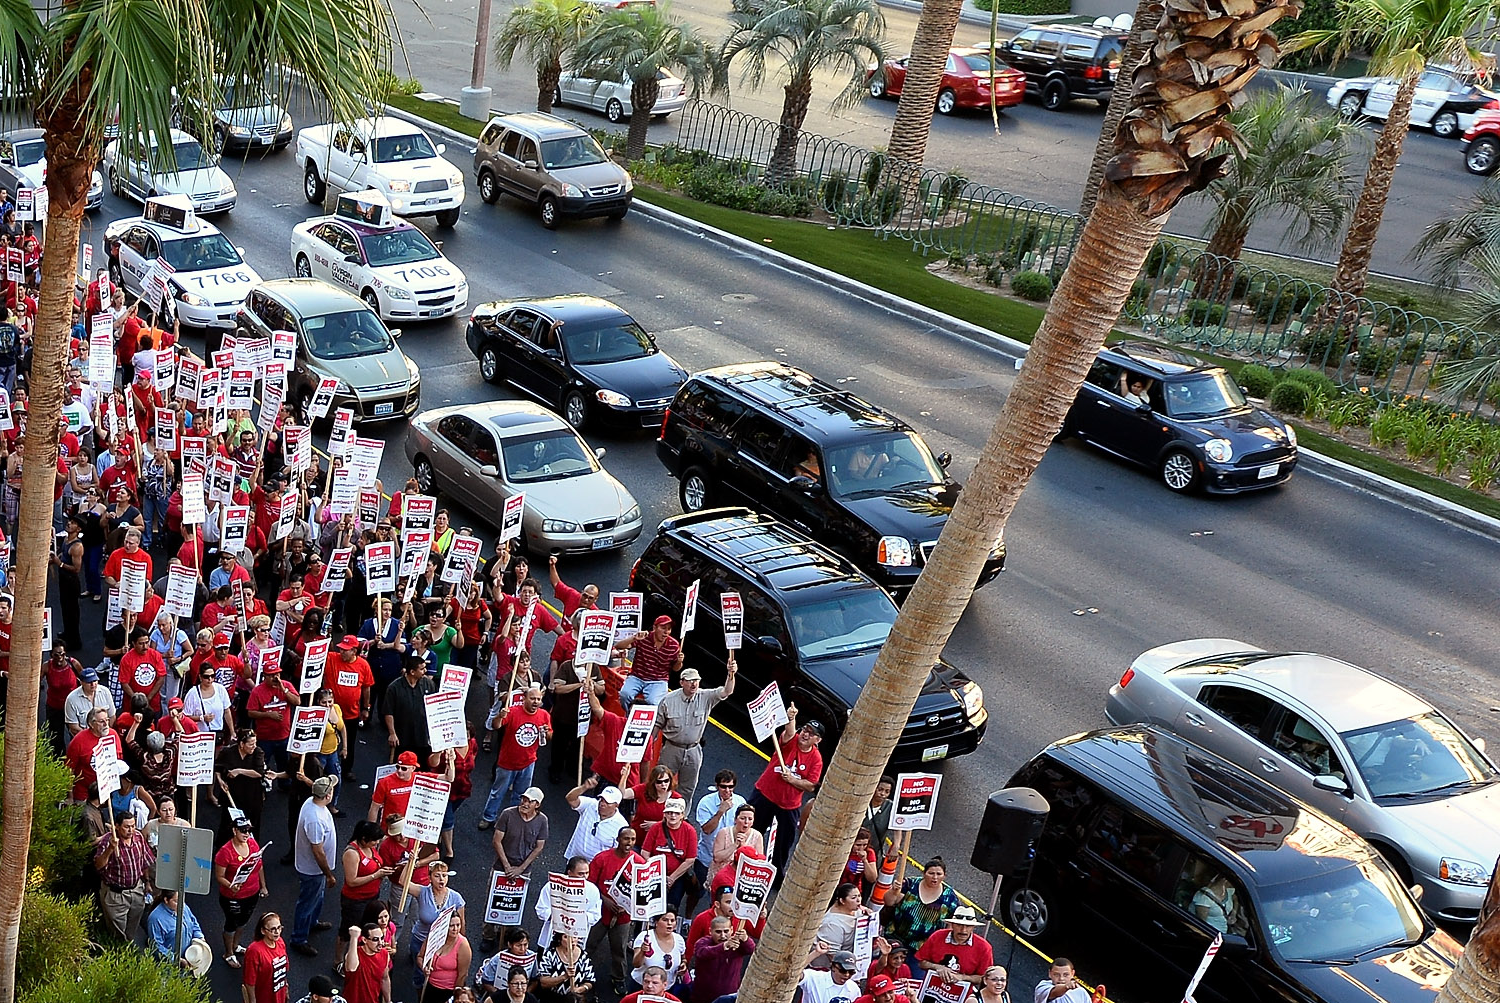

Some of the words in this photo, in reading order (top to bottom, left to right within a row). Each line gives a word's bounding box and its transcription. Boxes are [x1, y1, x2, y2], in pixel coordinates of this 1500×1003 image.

[190, 272, 251, 288] 7766
[394, 265, 450, 283] 7106
[744, 866, 755, 875] No
[550, 883, 584, 896] UNFAIR
[930, 985, 960, 1001] JUSTICE
